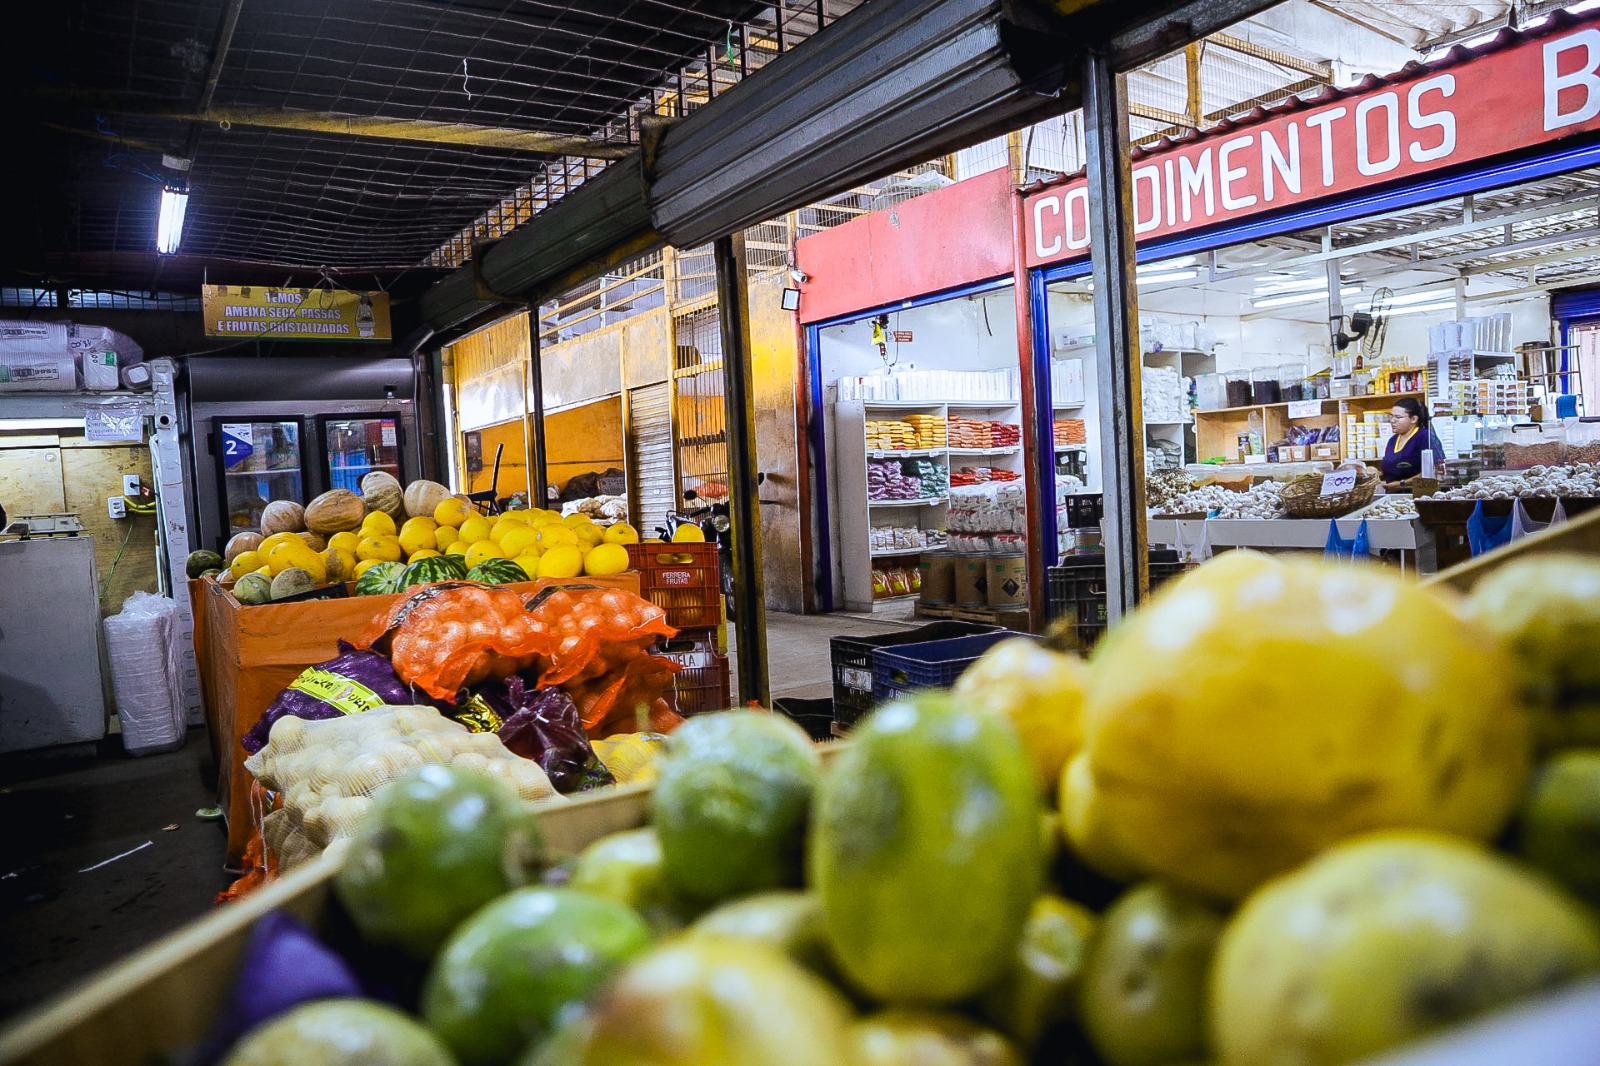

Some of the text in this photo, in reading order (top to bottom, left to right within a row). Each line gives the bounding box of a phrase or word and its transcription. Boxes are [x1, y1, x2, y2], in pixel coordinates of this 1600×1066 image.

[1034, 28, 1600, 259] CODIMENTOS B
[224, 306, 267, 318] AMEIXA
[300, 308, 341, 320] PASSAS
[217, 320, 350, 335] E FRUTAS CRISTALIZADAS
[225, 440, 238, 455] 2
